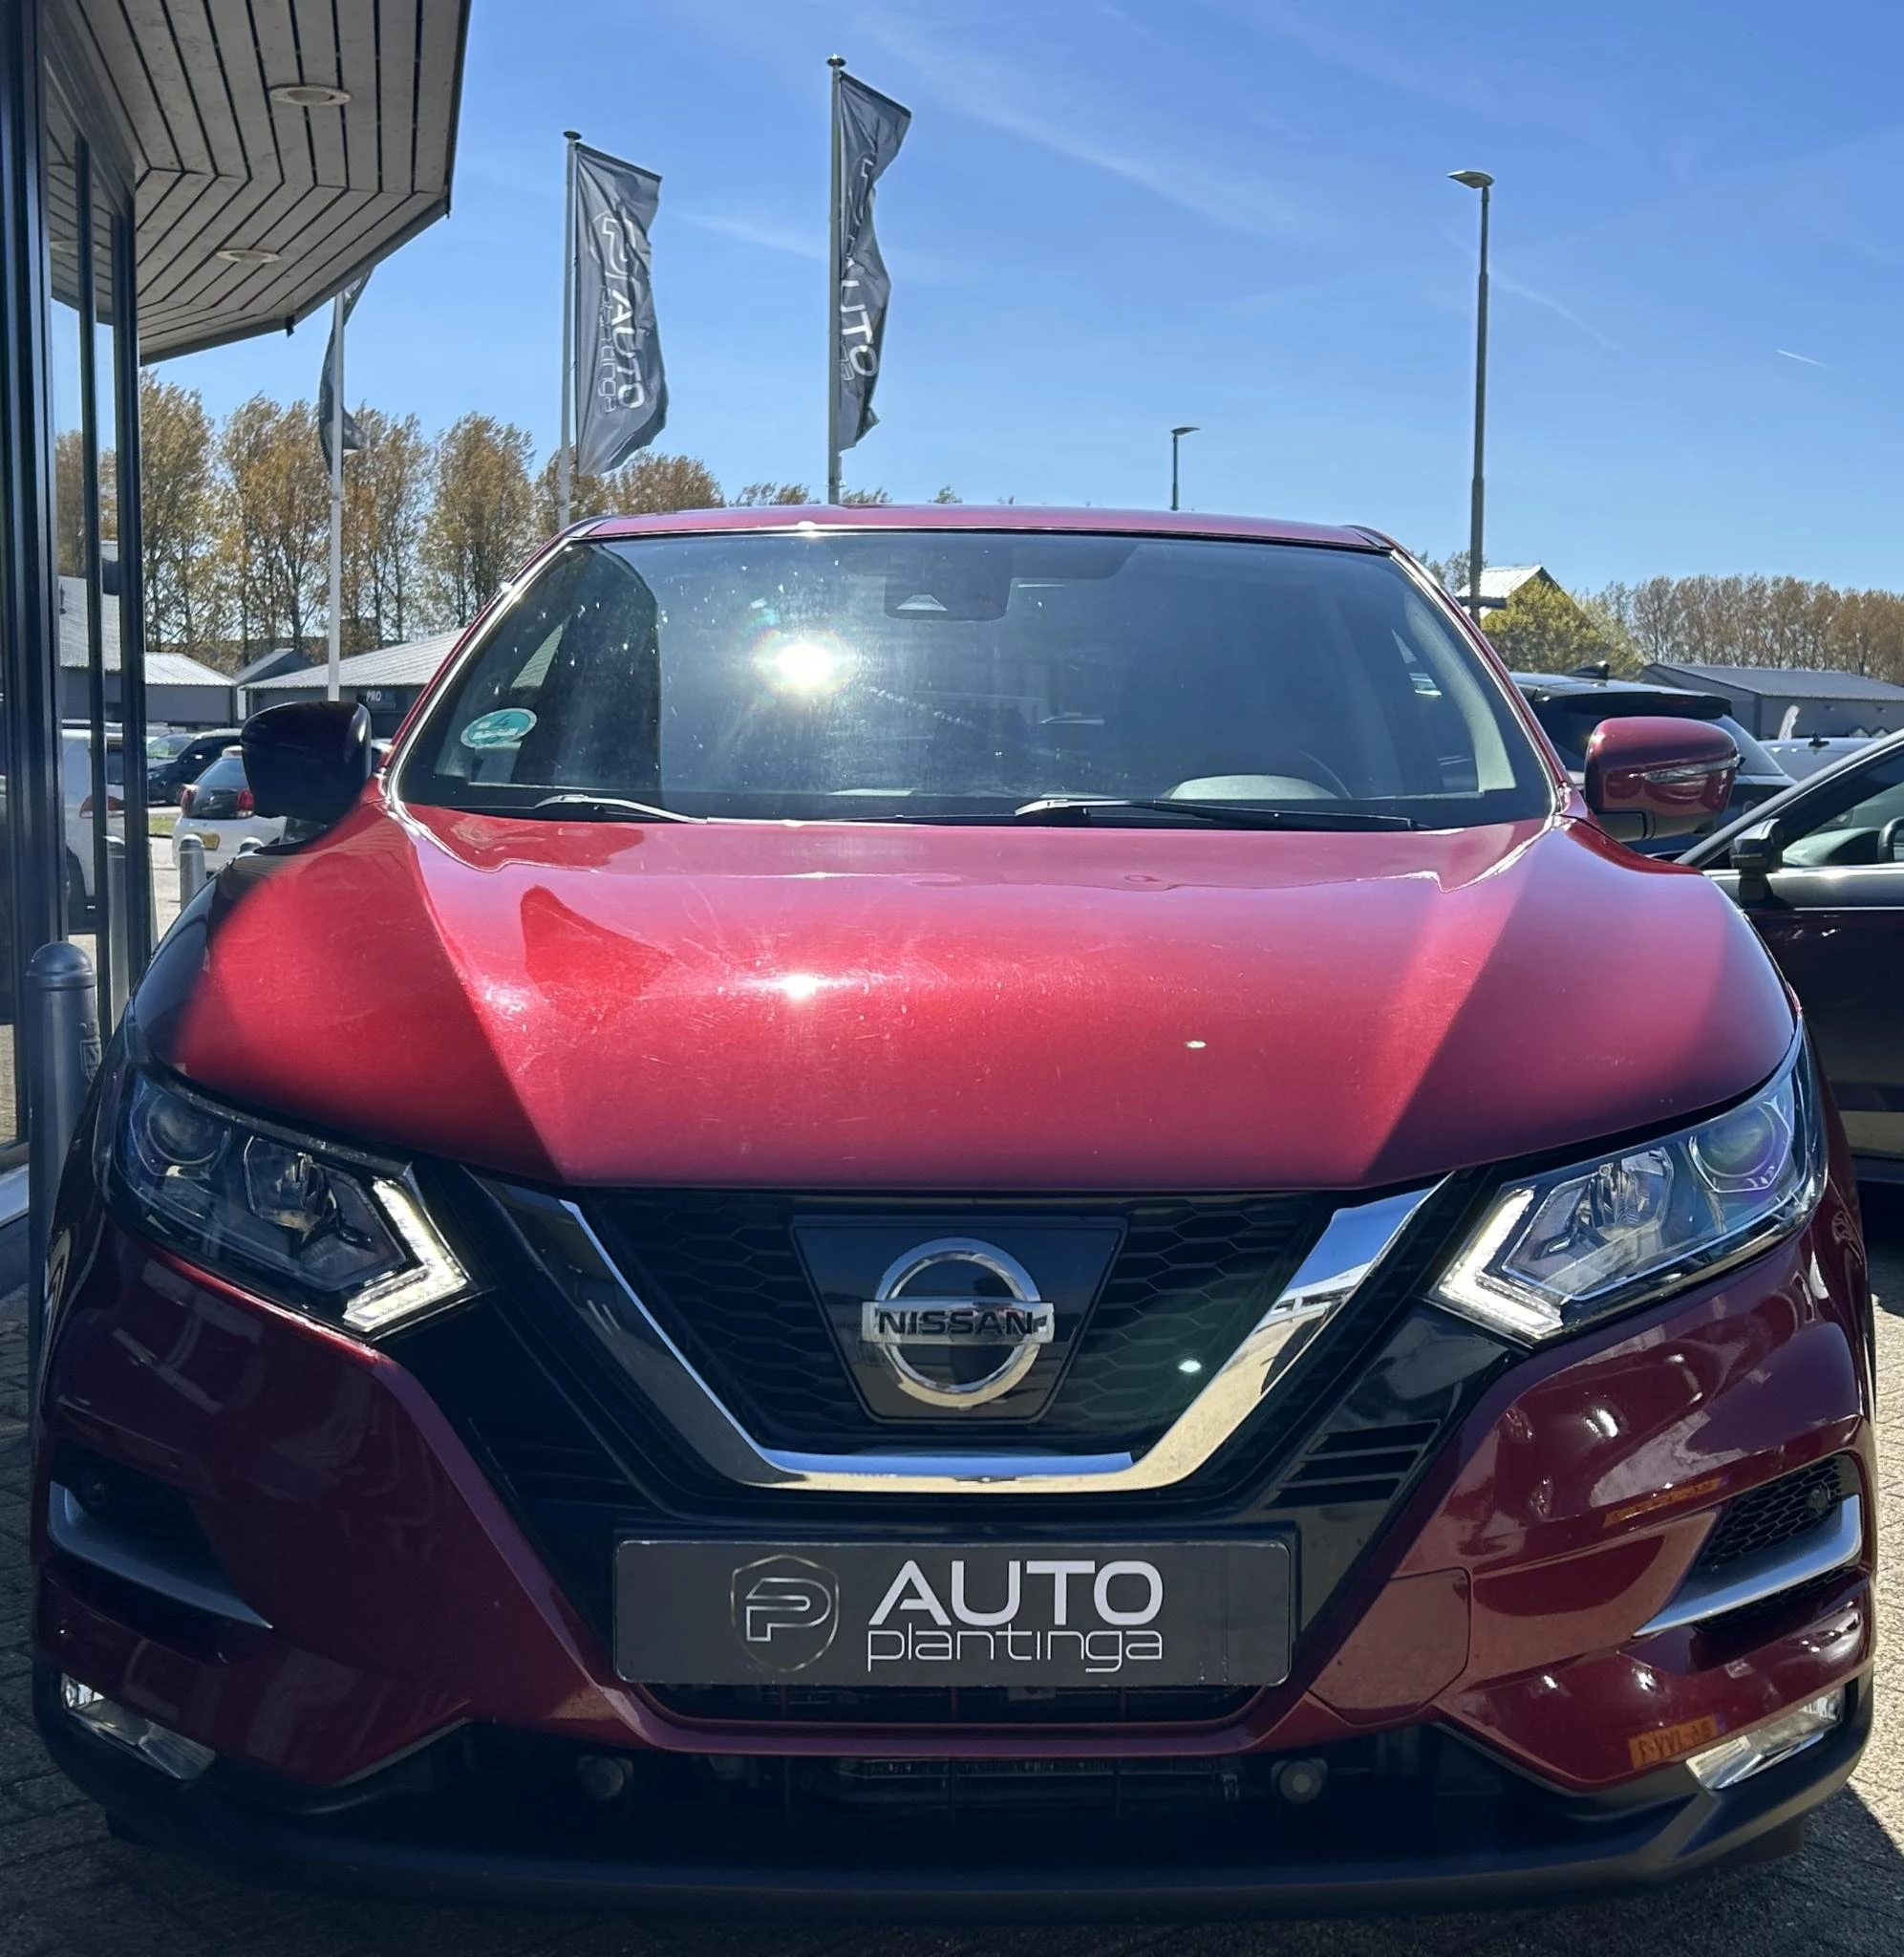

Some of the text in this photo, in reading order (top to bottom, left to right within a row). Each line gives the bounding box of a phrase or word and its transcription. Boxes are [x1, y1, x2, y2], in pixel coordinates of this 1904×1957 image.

[611, 290, 645, 409] AUTO
[878, 1309, 1034, 1336] NISSAN
[867, 1559, 1164, 1626] AUTO
[867, 1623, 1163, 1672] plantinga
